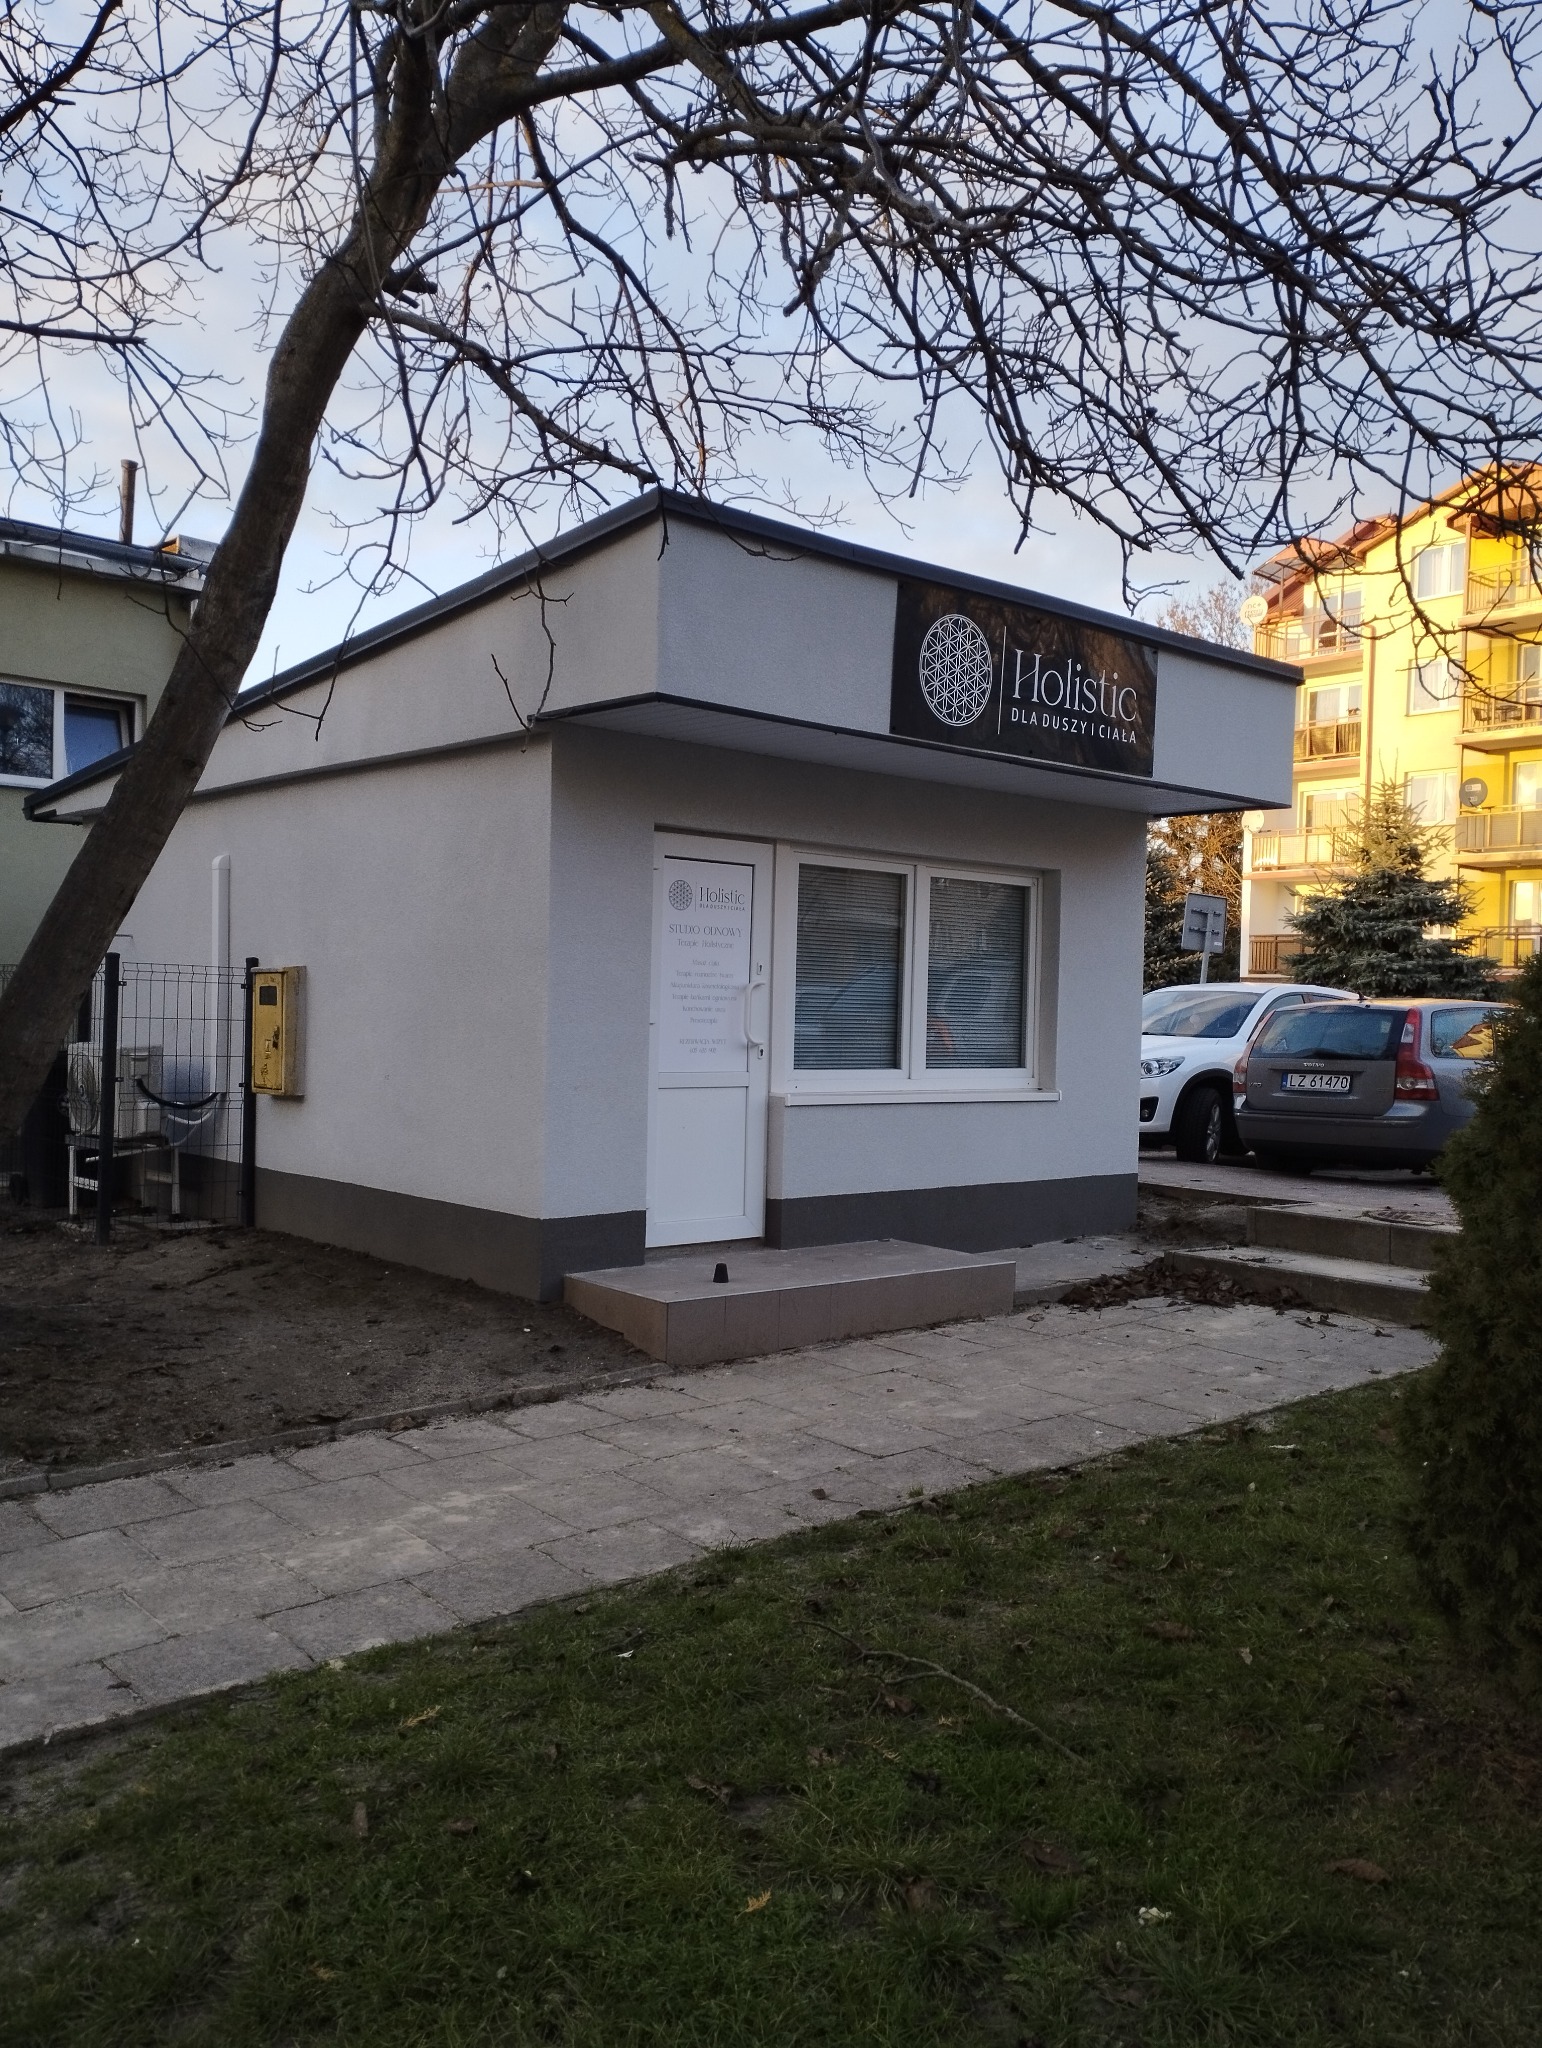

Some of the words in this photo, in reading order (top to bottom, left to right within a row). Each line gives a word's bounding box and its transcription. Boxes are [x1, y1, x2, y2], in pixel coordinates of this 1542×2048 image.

[1012, 649, 1137, 722] Holistic
[1011, 707, 1038, 726] DLA
[1042, 711, 1087, 735] DUSZY
[1091, 722, 1095, 736] I
[1098, 724, 1137, 744] CIAŁA
[700, 886, 745, 905] Holistic
[668, 924, 701, 935] STUDIO
[703, 926, 743, 938] ODNOWY
[1290, 1075, 1306, 1087] LZ
[1310, 1075, 1349, 1089] 61470
